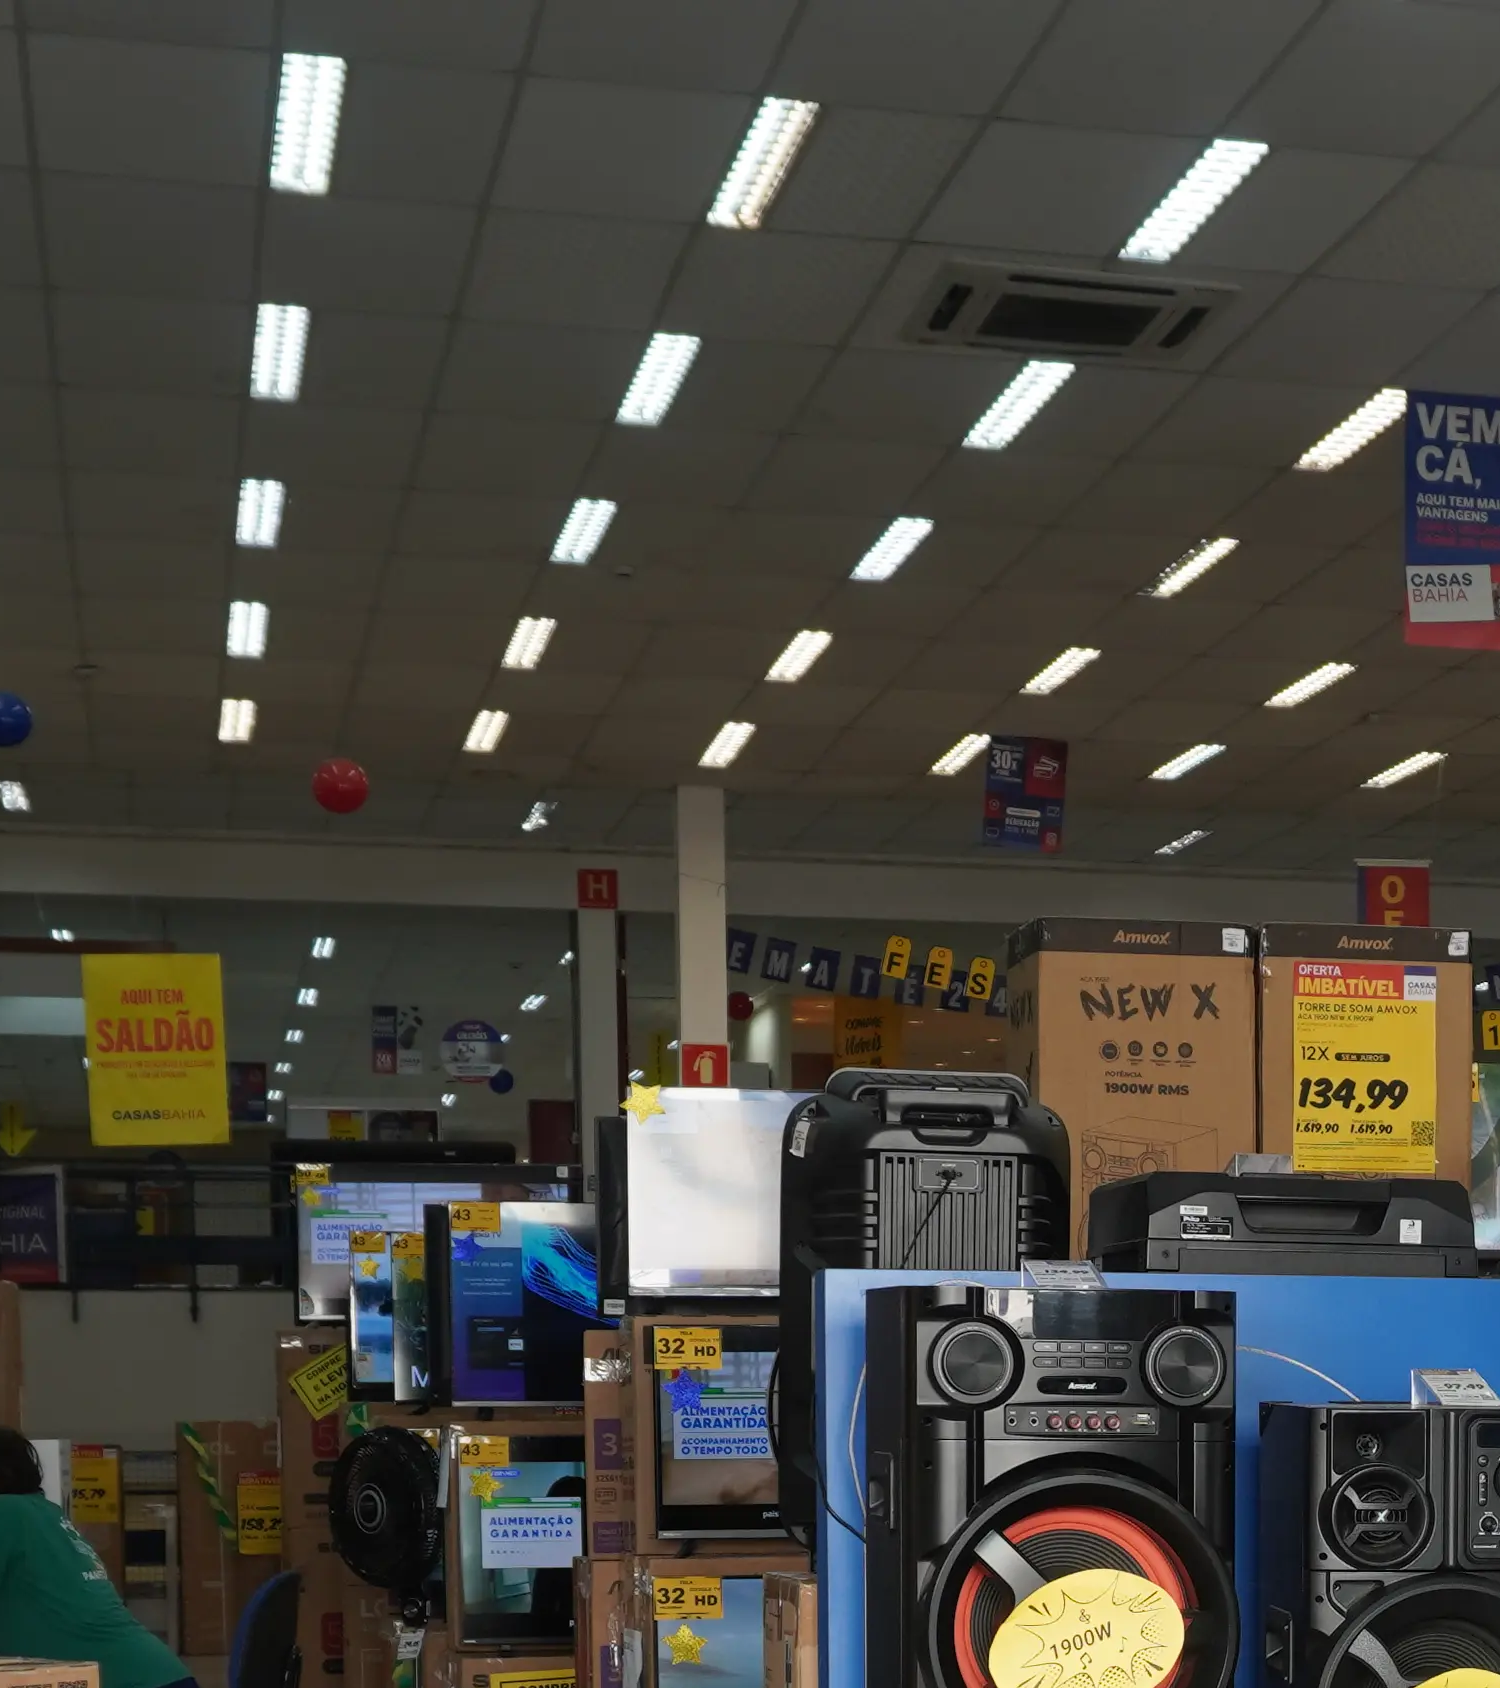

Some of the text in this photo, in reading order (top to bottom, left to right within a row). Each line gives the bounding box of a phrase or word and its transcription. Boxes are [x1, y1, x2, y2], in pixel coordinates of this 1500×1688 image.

[1415, 444, 1482, 491] CÁ,
[1416, 493, 1445, 506] AQUI
[1448, 495, 1473, 508] TEM
[1416, 506, 1488, 522] VANTAGENS
[1411, 572, 1473, 588] CASAS
[1412, 587, 1468, 602] BAHIA
[121, 987, 184, 1005] AQUI TEM
[95, 1009, 214, 1053] SALDÃO
[1298, 1073, 1409, 1116] 134,99
[452, 1209, 471, 1222] 43
[657, 1338, 718, 1358] 32 HD
[489, 1512, 574, 1529] ALIMENTAÇÃO
[489, 1528, 573, 1541] GARANTIDA
[1050, 1620, 1113, 1660] 1900W
